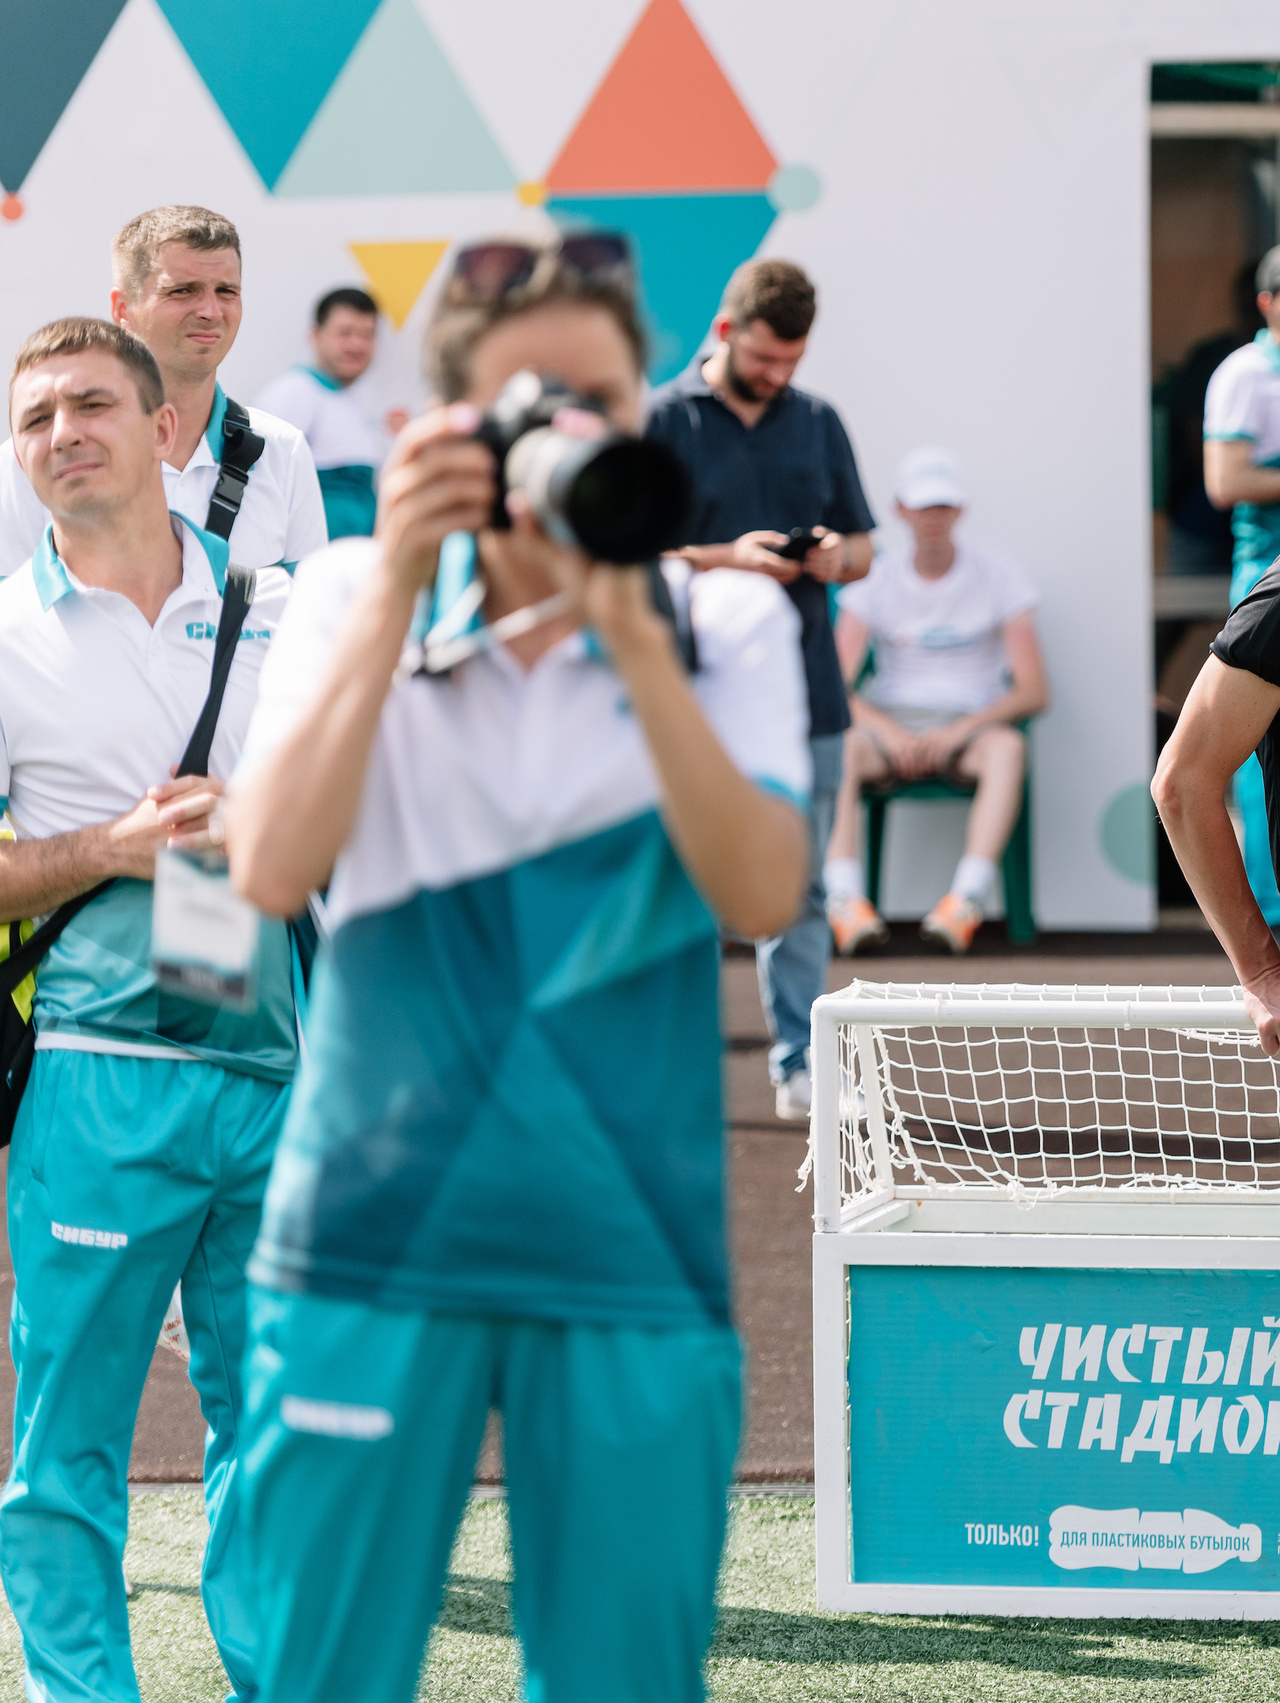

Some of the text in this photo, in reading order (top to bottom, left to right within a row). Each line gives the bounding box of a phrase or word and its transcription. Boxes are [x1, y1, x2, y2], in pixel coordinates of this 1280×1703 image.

[51, 1220, 128, 1251] СИБУР
[965, 1524, 1250, 1551] ТОЛЬКО! ДЛЯ ПЛАСТИКОВЫХ БУТЫЛОК
